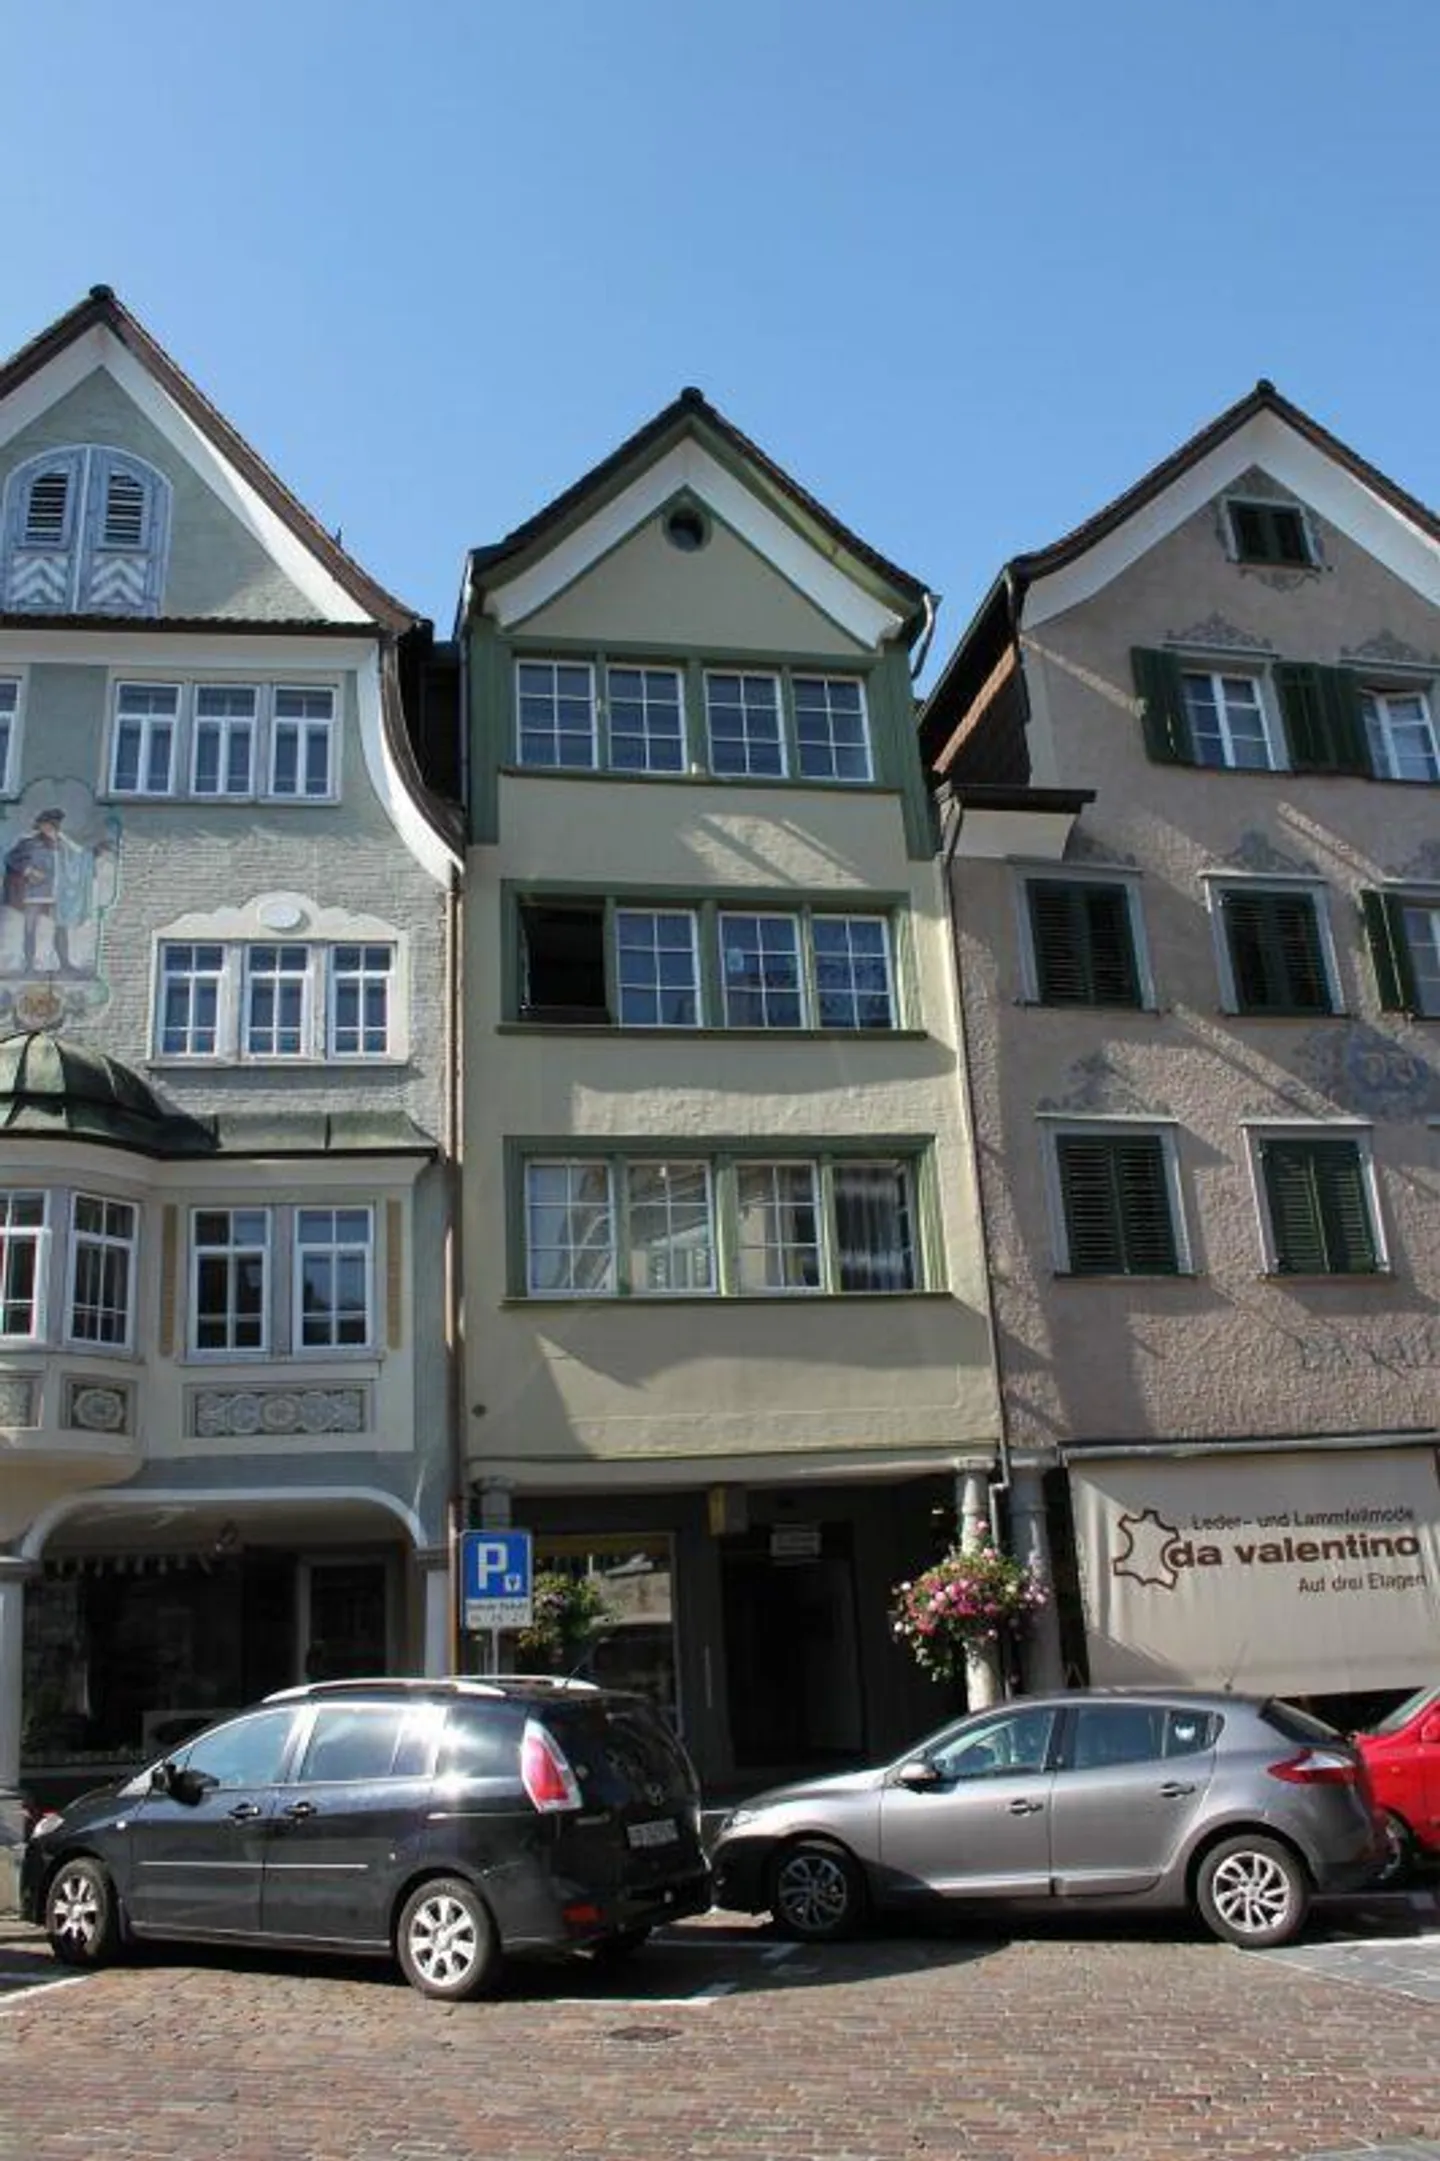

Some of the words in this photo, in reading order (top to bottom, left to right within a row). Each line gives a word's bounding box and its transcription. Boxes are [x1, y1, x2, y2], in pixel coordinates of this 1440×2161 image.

[1258, 1510, 1290, 1528] und
[1168, 1540, 1223, 1568] da
[1234, 1532, 1422, 1566] valentino
[477, 1542, 508, 1590] P
[1298, 1575, 1326, 1593] Auf
[1331, 1573, 1364, 1591] drei
[1368, 1570, 1428, 1593] Etagen
